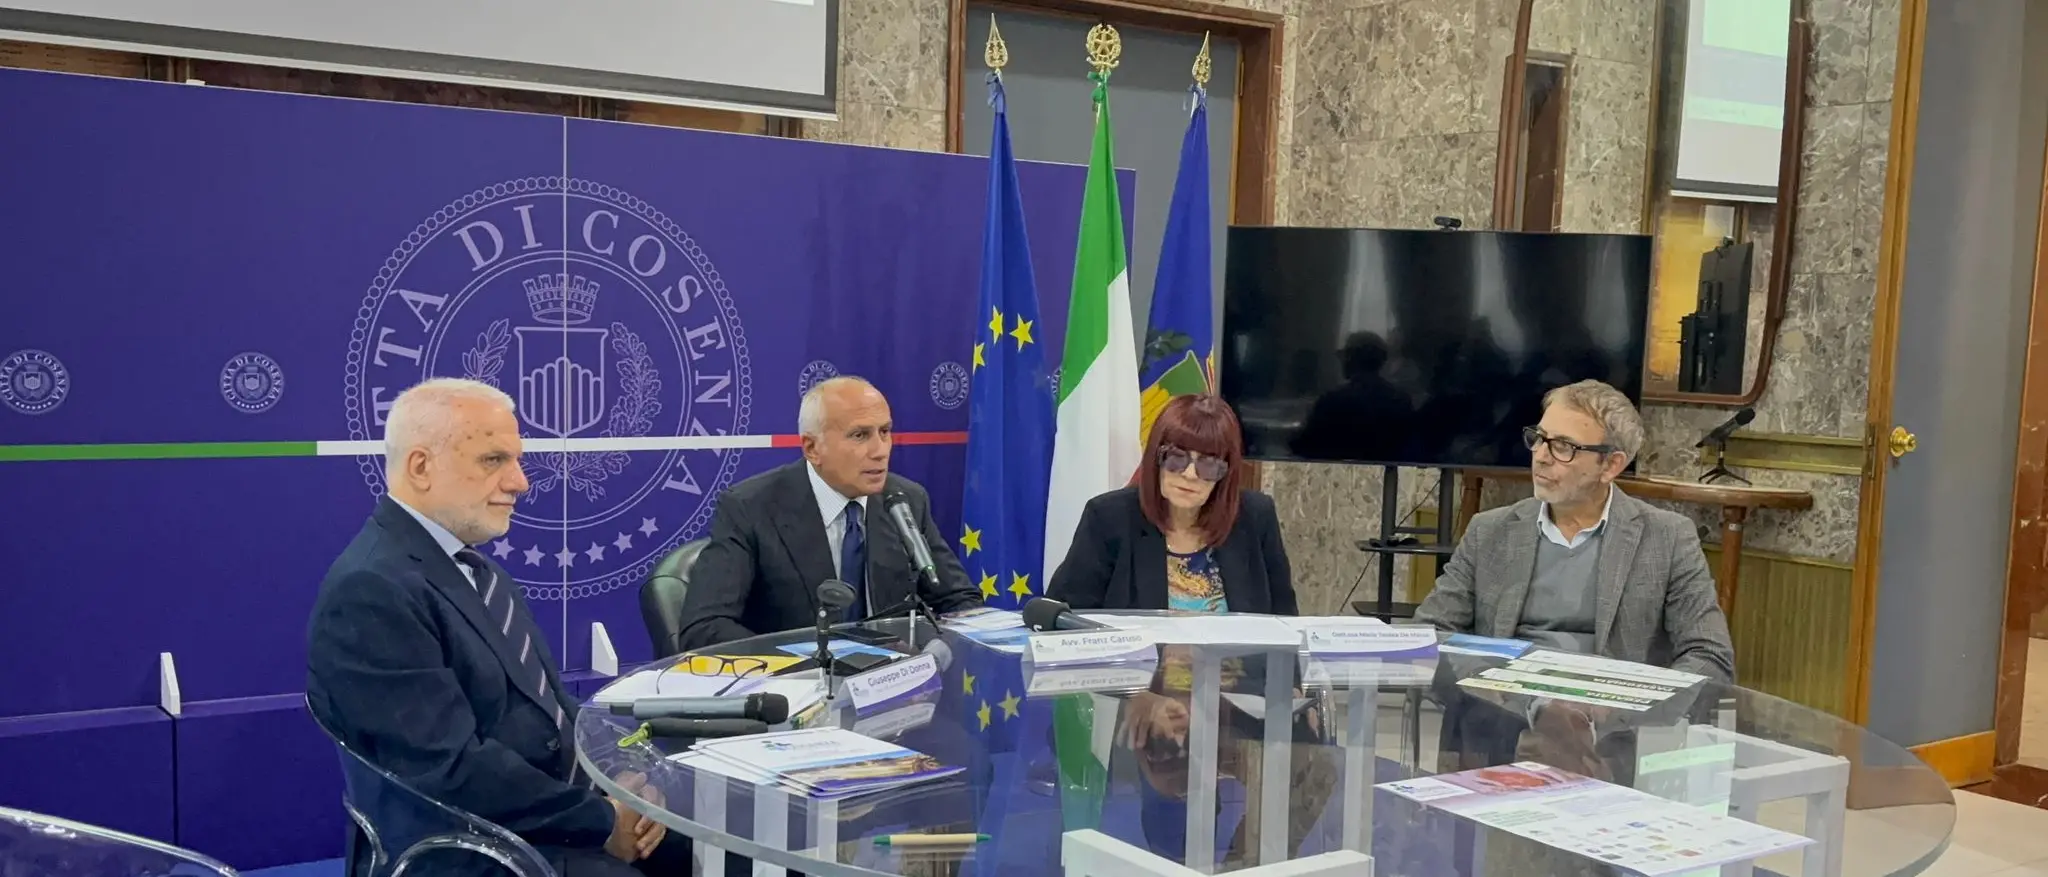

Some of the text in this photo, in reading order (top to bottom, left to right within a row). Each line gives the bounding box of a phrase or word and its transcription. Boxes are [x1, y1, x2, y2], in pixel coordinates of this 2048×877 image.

[453, 204, 542, 272] DI
[582, 209, 732, 496] COSENZA
[13, 353, 28, 365] DI
[34, 353, 66, 399] COSENZA
[235, 355, 248, 366] DI
[254, 355, 281, 399] COSENZA
[1061, 634, 1143, 647] Avv. Franz Caruso
[867, 671, 901, 687] Giuseppe
[900, 667, 910, 677] Di
[909, 661, 931, 675] Donna
